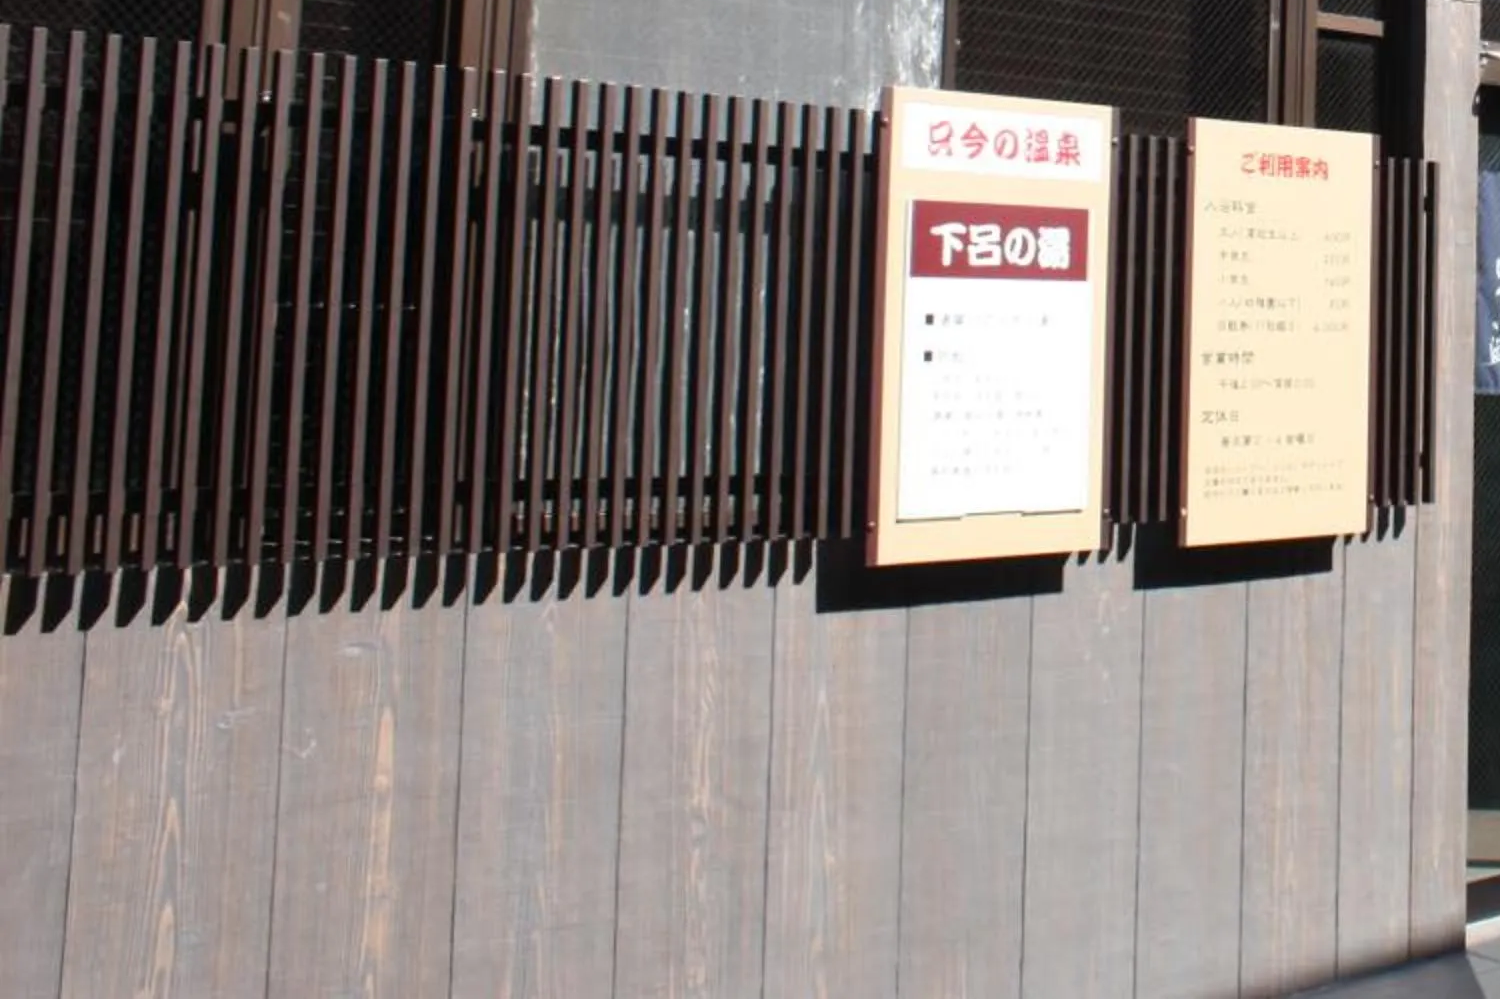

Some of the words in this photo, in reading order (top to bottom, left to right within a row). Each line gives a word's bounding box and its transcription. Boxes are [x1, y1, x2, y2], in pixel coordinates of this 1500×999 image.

[928, 120, 1081, 166] 只今の温泉
[1241, 153, 1329, 180] ご利用案内
[930, 222, 1071, 270] 下呂の湯
